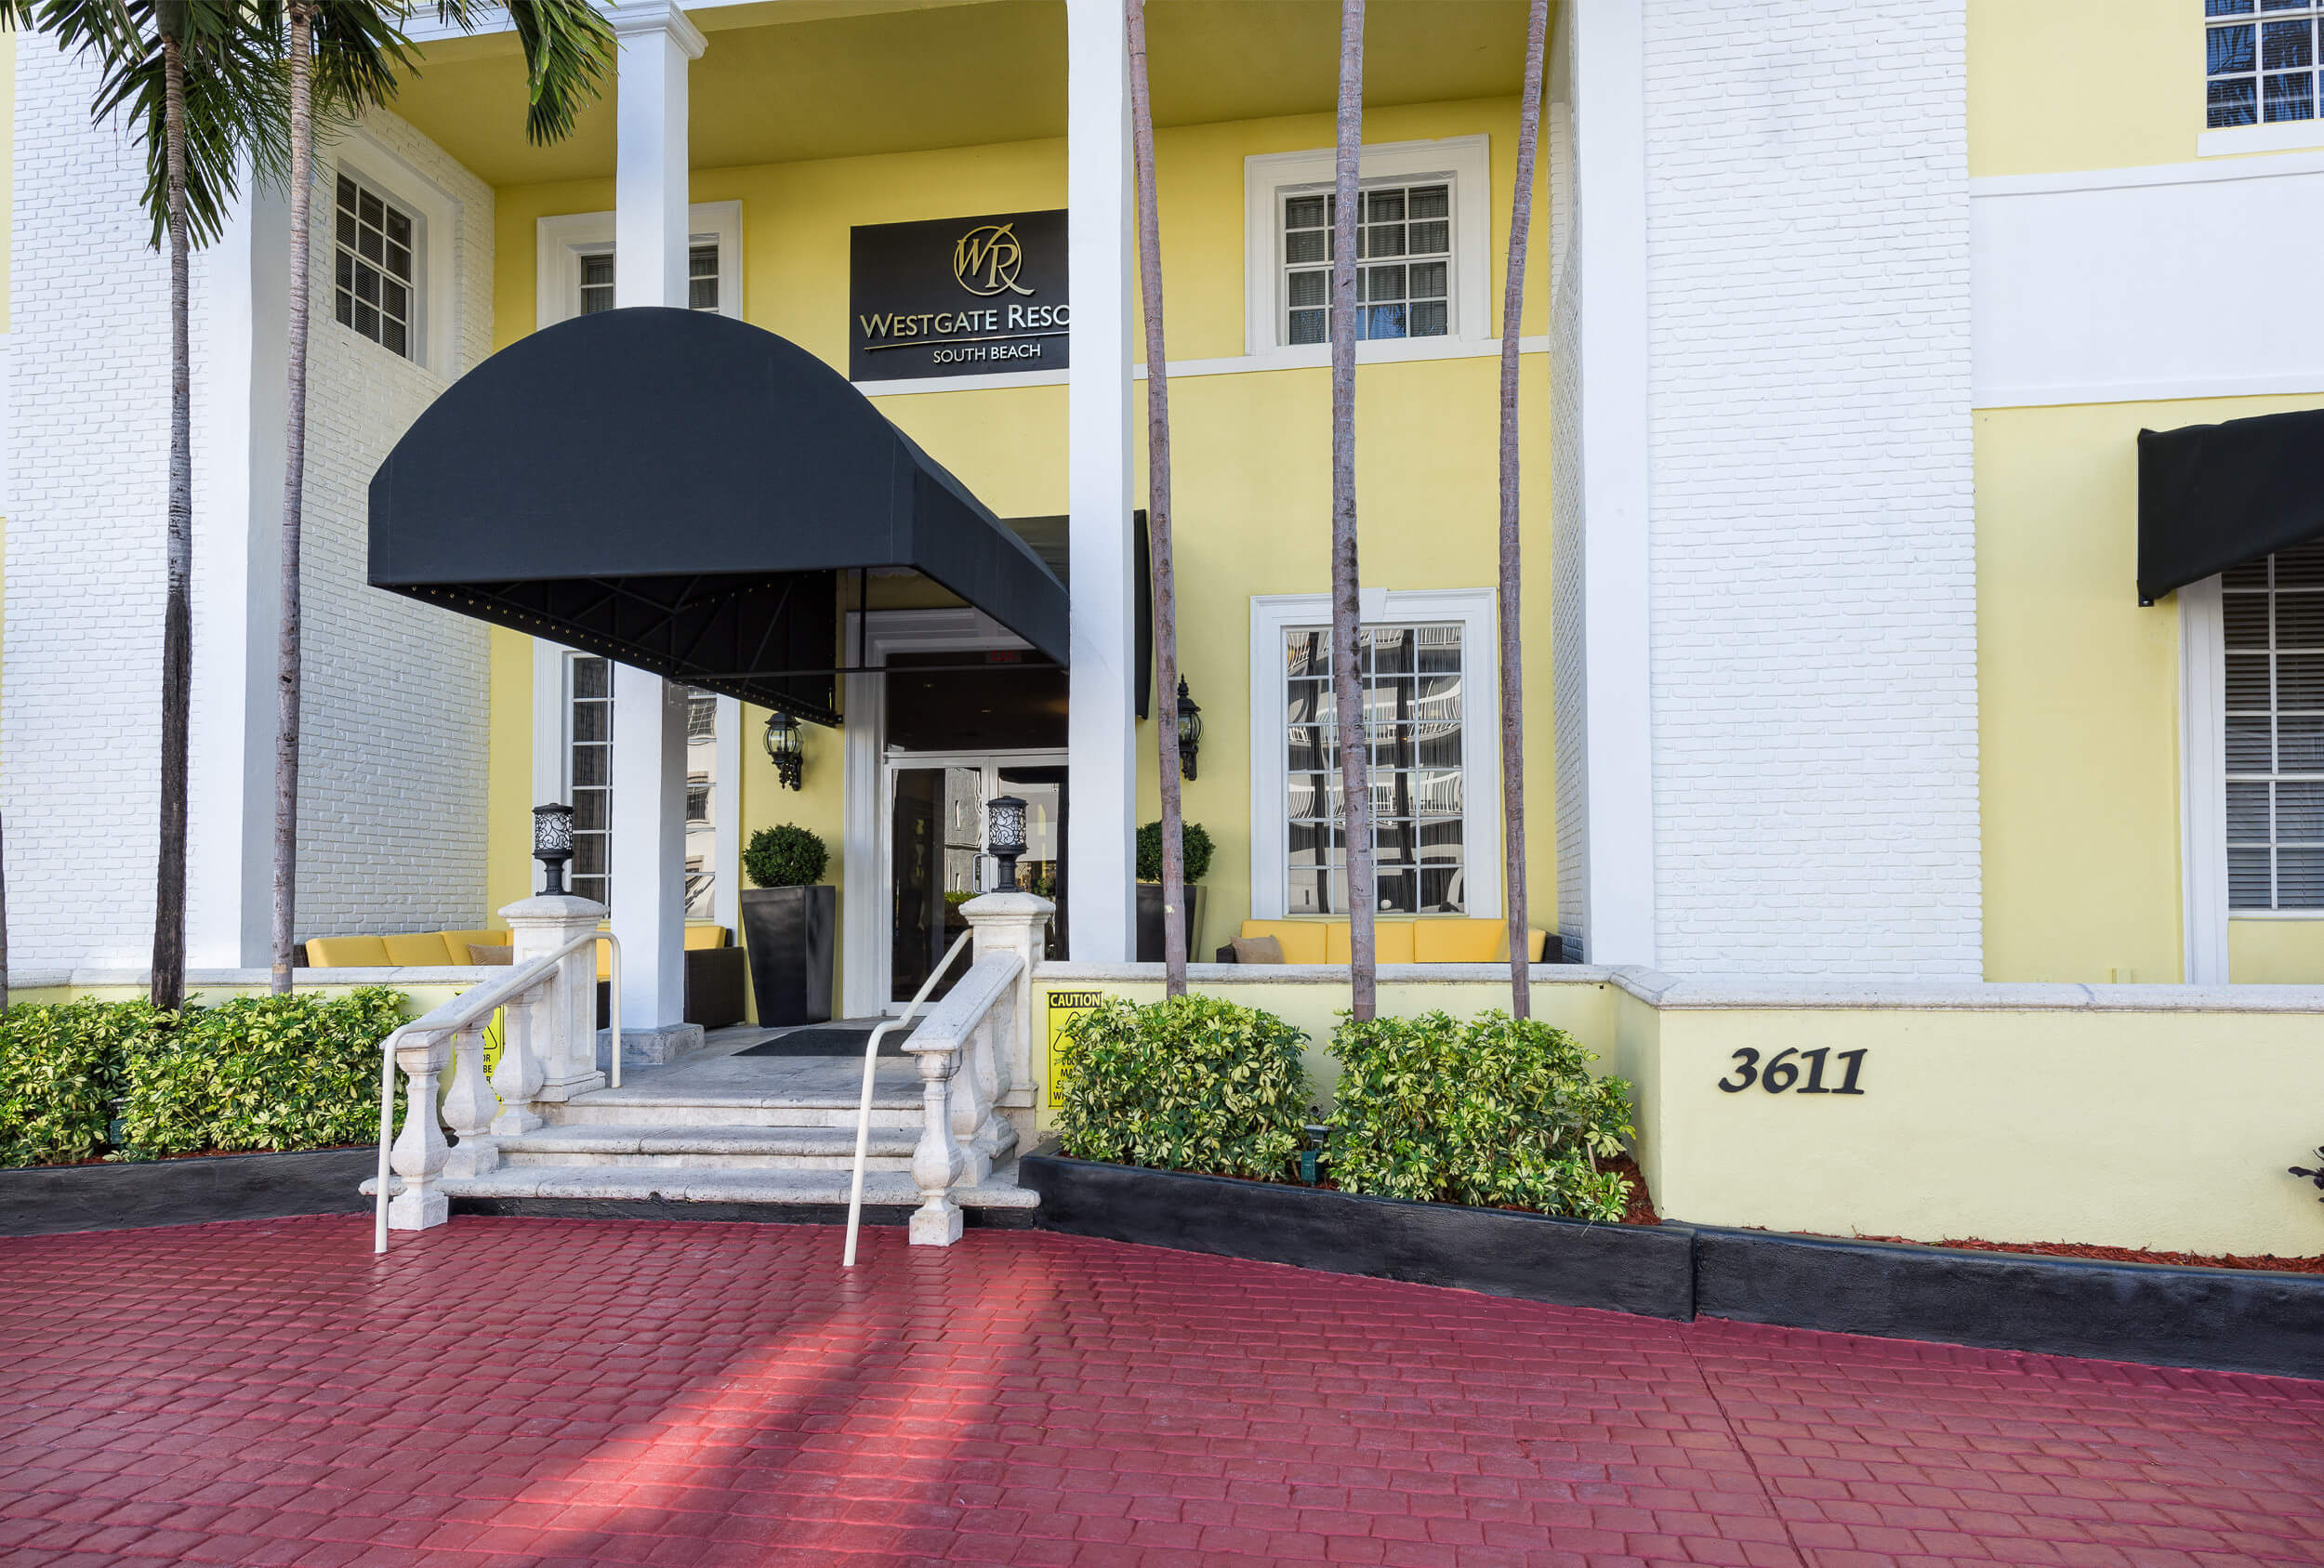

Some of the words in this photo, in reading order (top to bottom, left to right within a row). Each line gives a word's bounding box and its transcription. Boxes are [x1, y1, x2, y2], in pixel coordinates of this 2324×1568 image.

[859, 310, 998, 338] WESTGATE
[1008, 304, 1069, 329] RESO
[932, 346, 986, 364] SOUTH
[990, 344, 1041, 360] BEACH
[1050, 994, 1101, 1007] CAUTION
[1718, 1047, 1868, 1095] 3611
